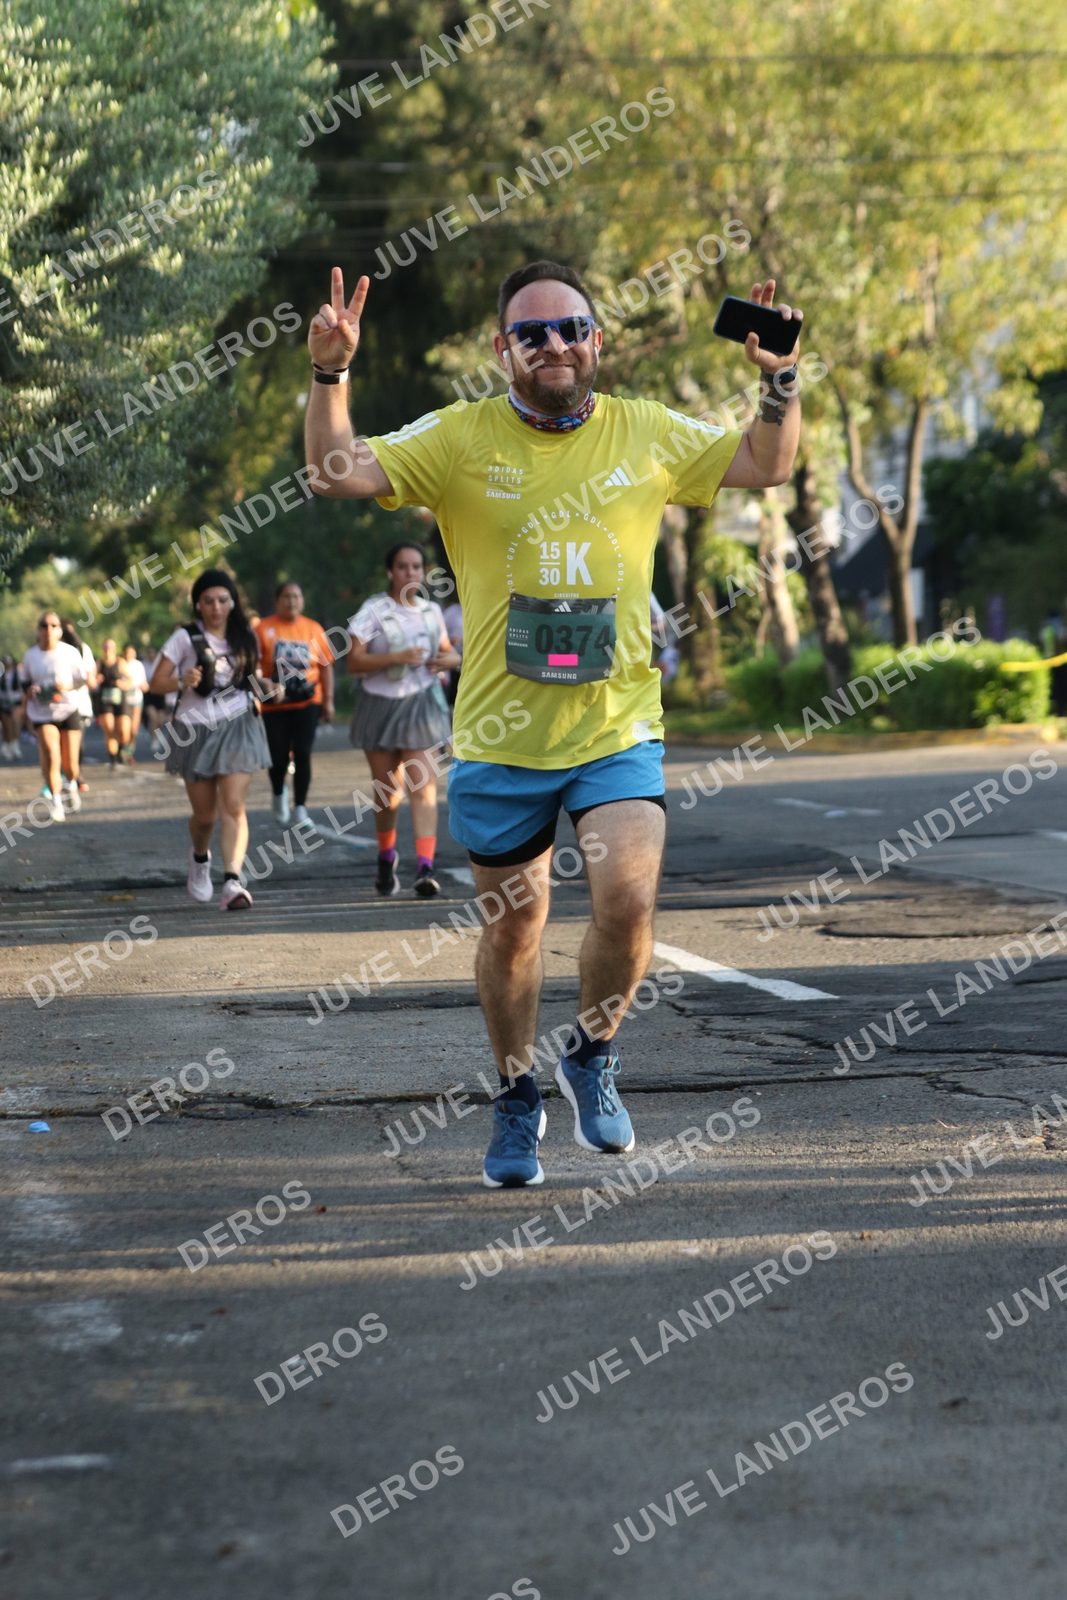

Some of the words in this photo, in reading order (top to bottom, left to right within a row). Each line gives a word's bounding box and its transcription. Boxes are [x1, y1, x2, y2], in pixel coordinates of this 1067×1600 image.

[488, 465, 524, 475] ADIDAS
[488, 475, 521, 484] SPLITS
[486, 490, 520, 500] SAMSUNG
[540, 541, 560, 560] 15
[566, 542, 594, 586] K
[538, 568, 560, 586] 30
[534, 623, 613, 657] 0374
[542, 672, 577, 680] SAMSUNG
